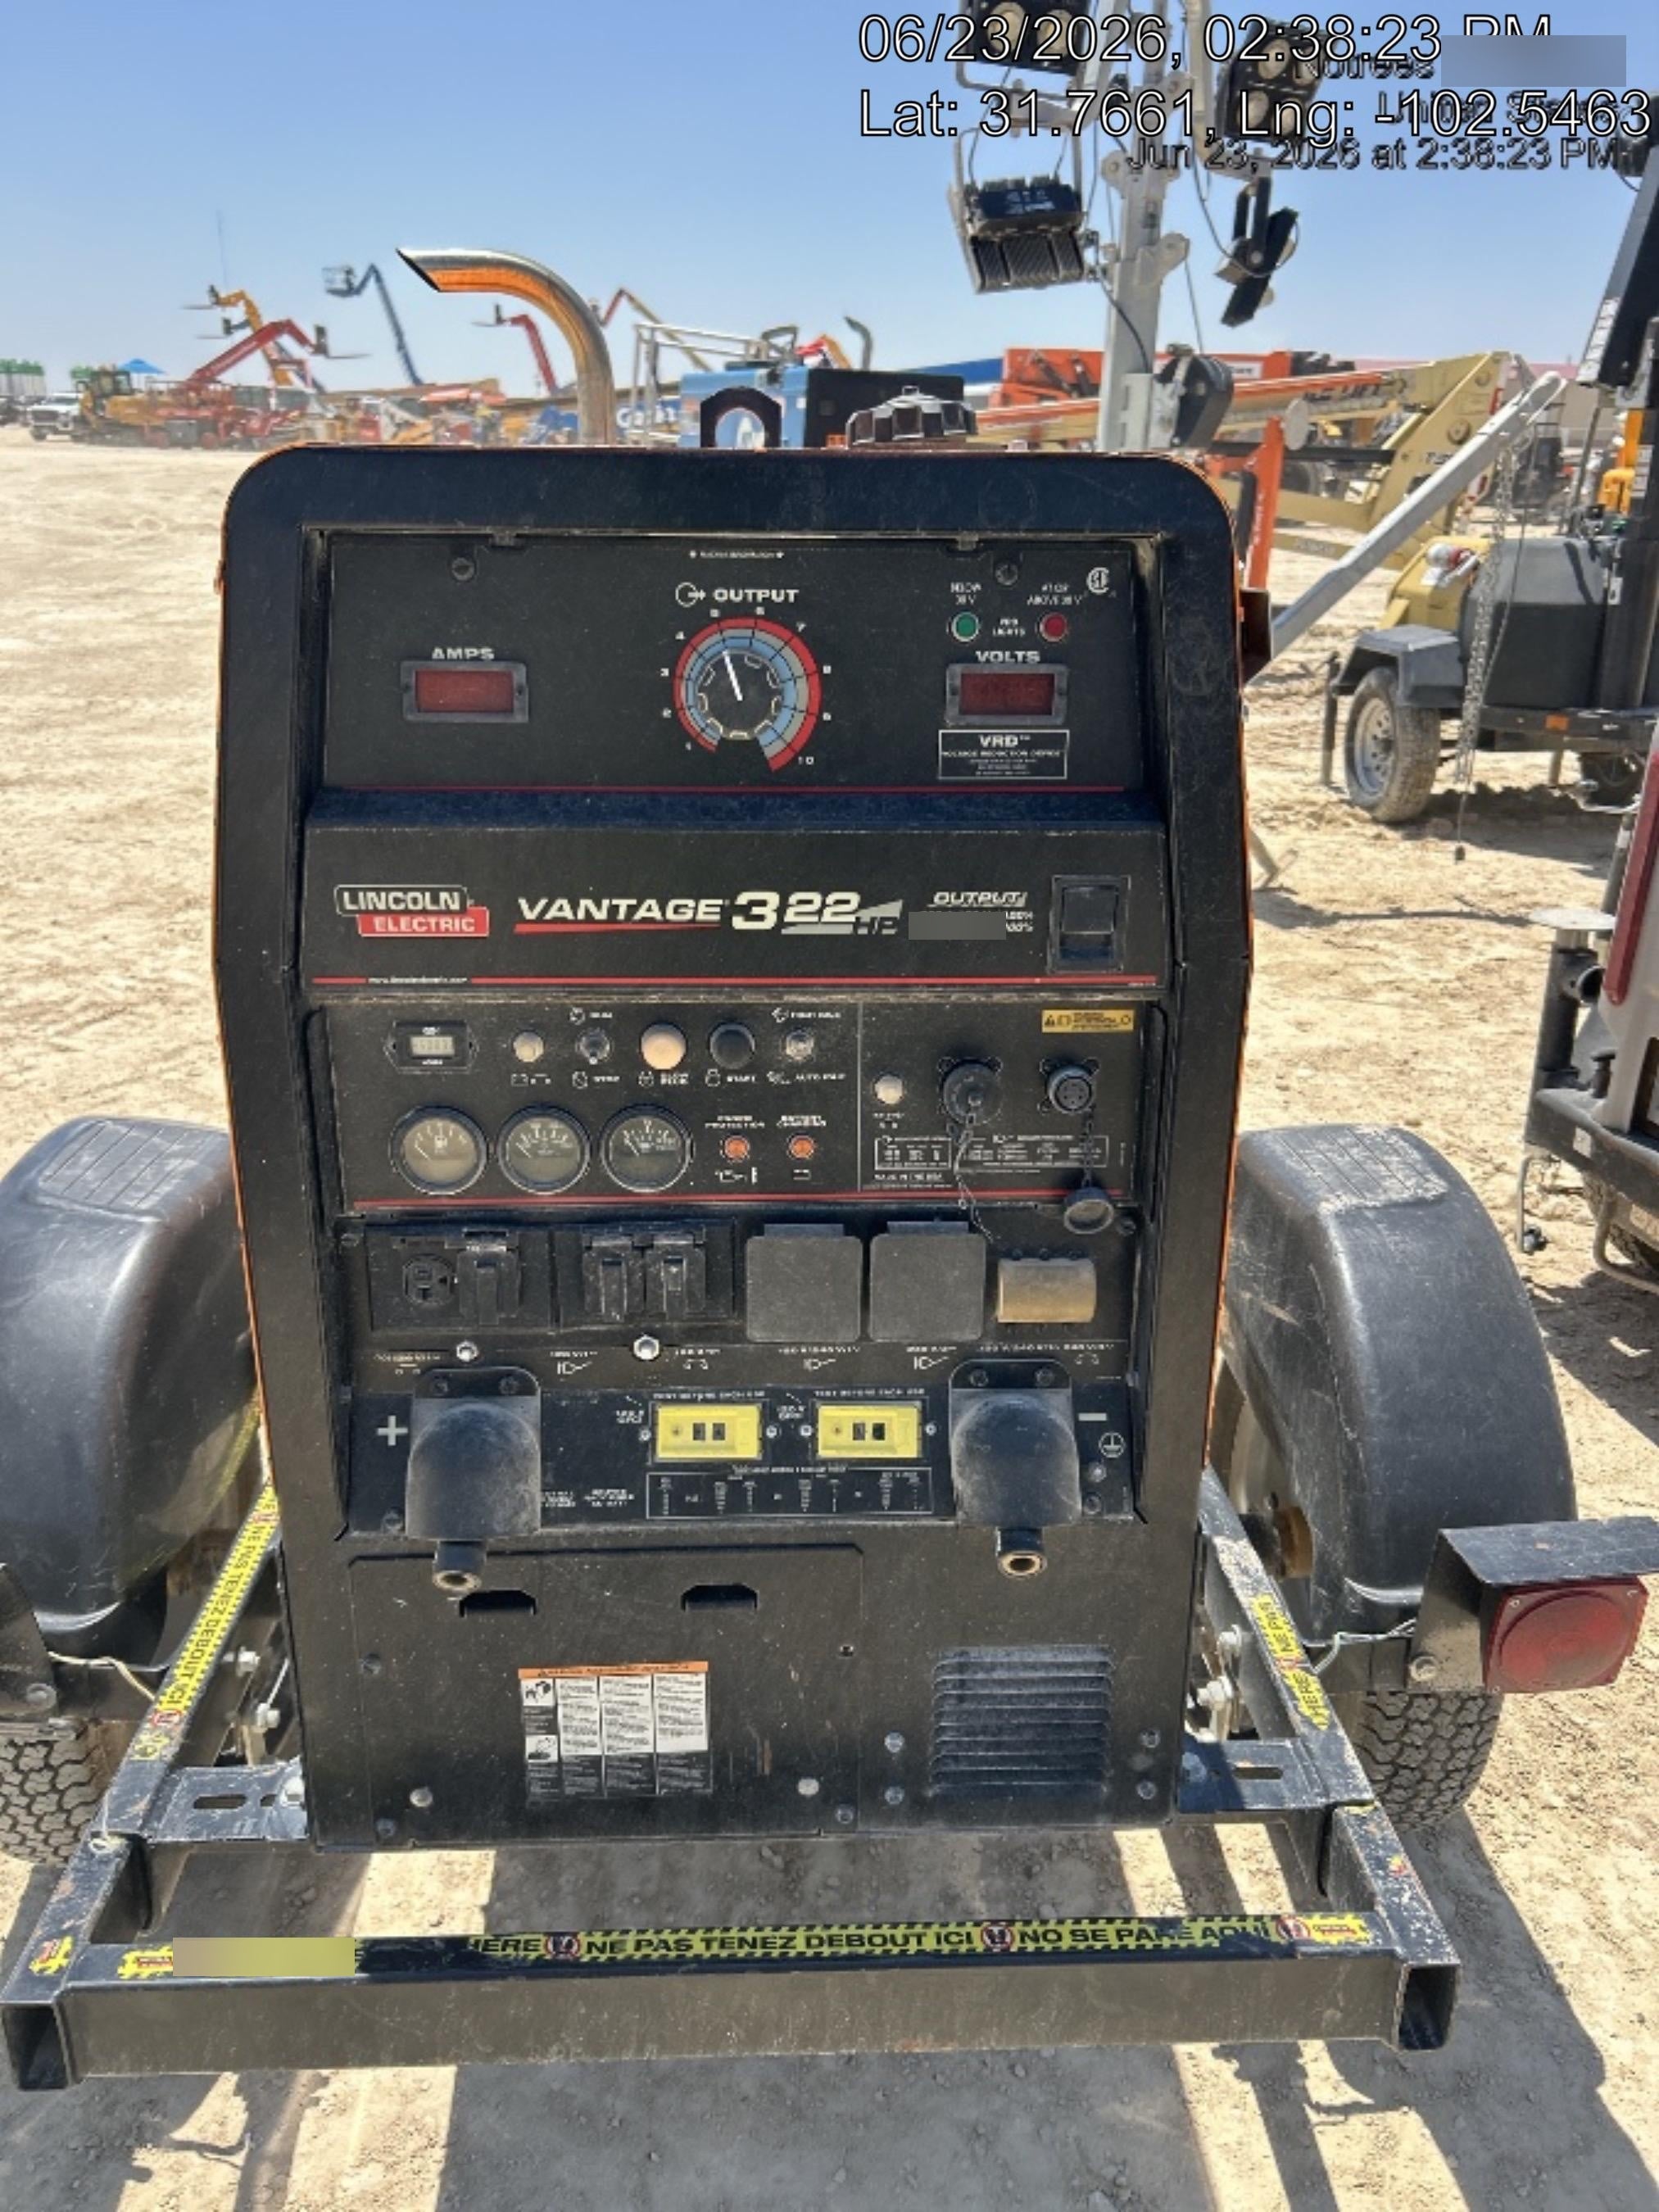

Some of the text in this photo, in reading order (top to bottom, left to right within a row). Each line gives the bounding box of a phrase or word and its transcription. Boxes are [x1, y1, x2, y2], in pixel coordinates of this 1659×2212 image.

[713, 588, 800, 603] OUTPUT
[431, 646, 496, 660] AMPS
[975, 650, 1041, 663] VOLTS
[342, 891, 460, 912] LINCOLN
[932, 891, 1022, 904] OUTPUT
[731, 891, 861, 931] 322
[373, 916, 476, 933] ELECTRIC
[586, 1941, 627, 1955] NE
[634, 1938, 694, 1953] PAS
[700, 1936, 797, 1951] TENEZ
[805, 1933, 927, 1949] DEBOUT
[936, 1932, 972, 1945] ICI
[1019, 1930, 1063, 1945] NO
[1070, 1929, 1108, 1943] SE
